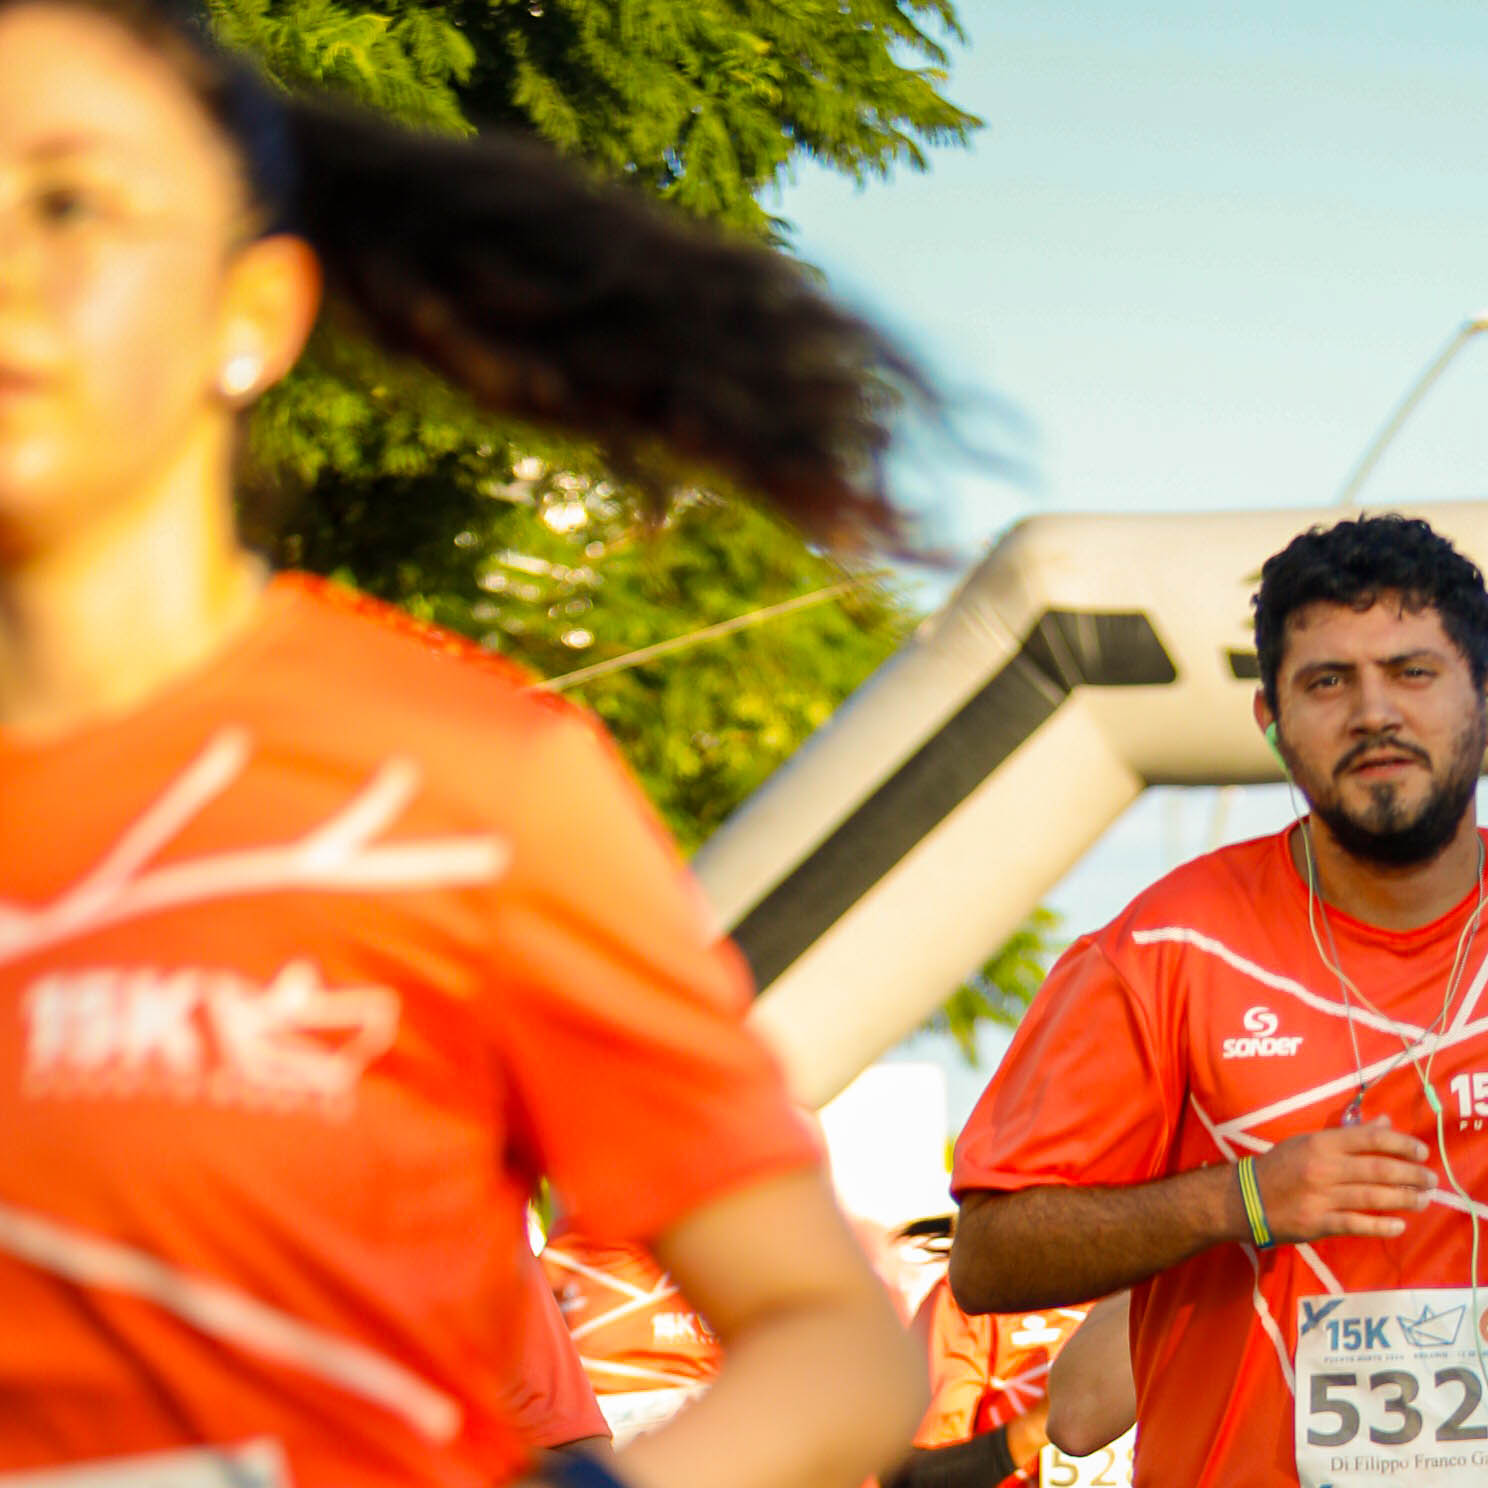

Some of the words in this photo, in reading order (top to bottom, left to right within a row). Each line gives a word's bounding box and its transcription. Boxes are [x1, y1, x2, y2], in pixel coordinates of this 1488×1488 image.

[1325, 1316, 1392, 1351] 15K
[1331, 1456, 1349, 1472] Di
[1354, 1454, 1409, 1475] Filippo
[1414, 1453, 1467, 1469] Franco
